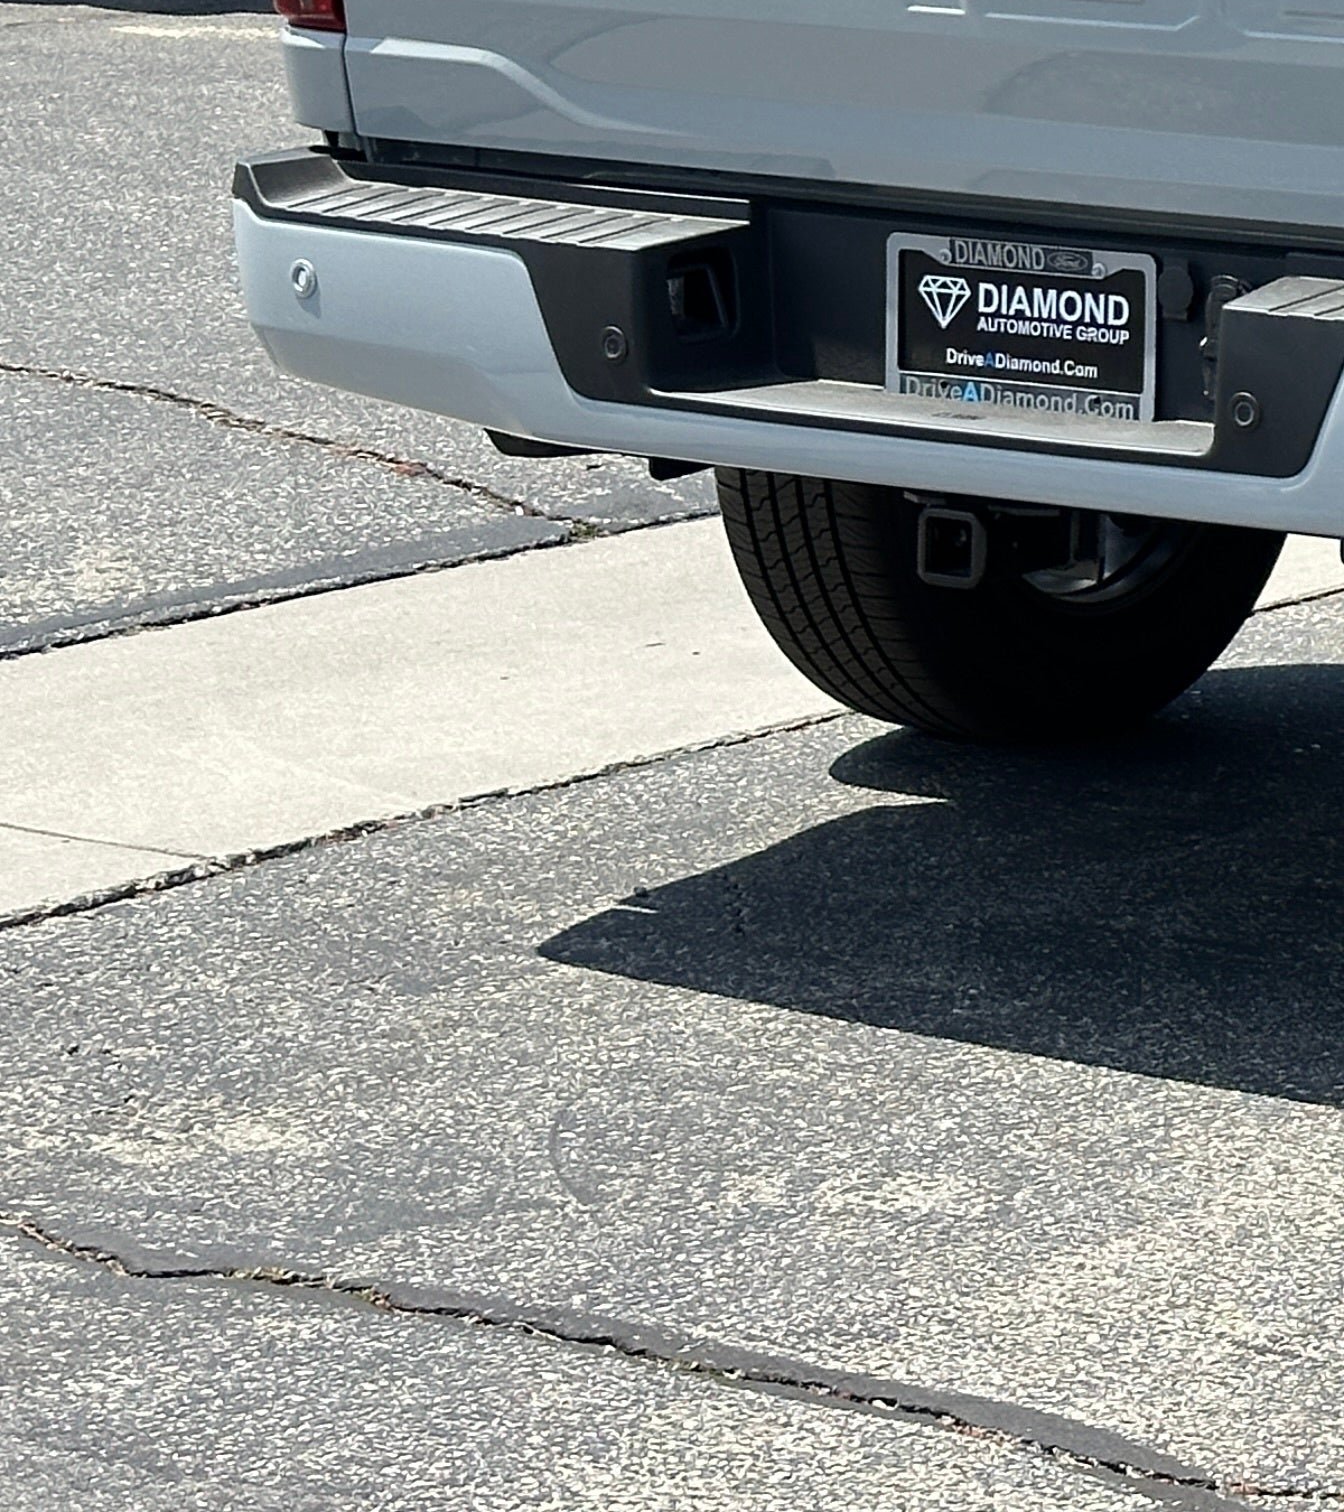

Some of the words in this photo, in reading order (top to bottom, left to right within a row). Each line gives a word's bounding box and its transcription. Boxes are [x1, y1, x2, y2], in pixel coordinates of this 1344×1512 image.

[954, 240, 1046, 271] DIAMOND
[977, 282, 1130, 327] DIAMOND
[977, 316, 1073, 340] AUTOMOTIVE
[1076, 328, 1130, 346] GROUP
[946, 348, 1098, 378] DriveADiamond.Com
[905, 376, 1135, 421] DriveADiamond.Com
